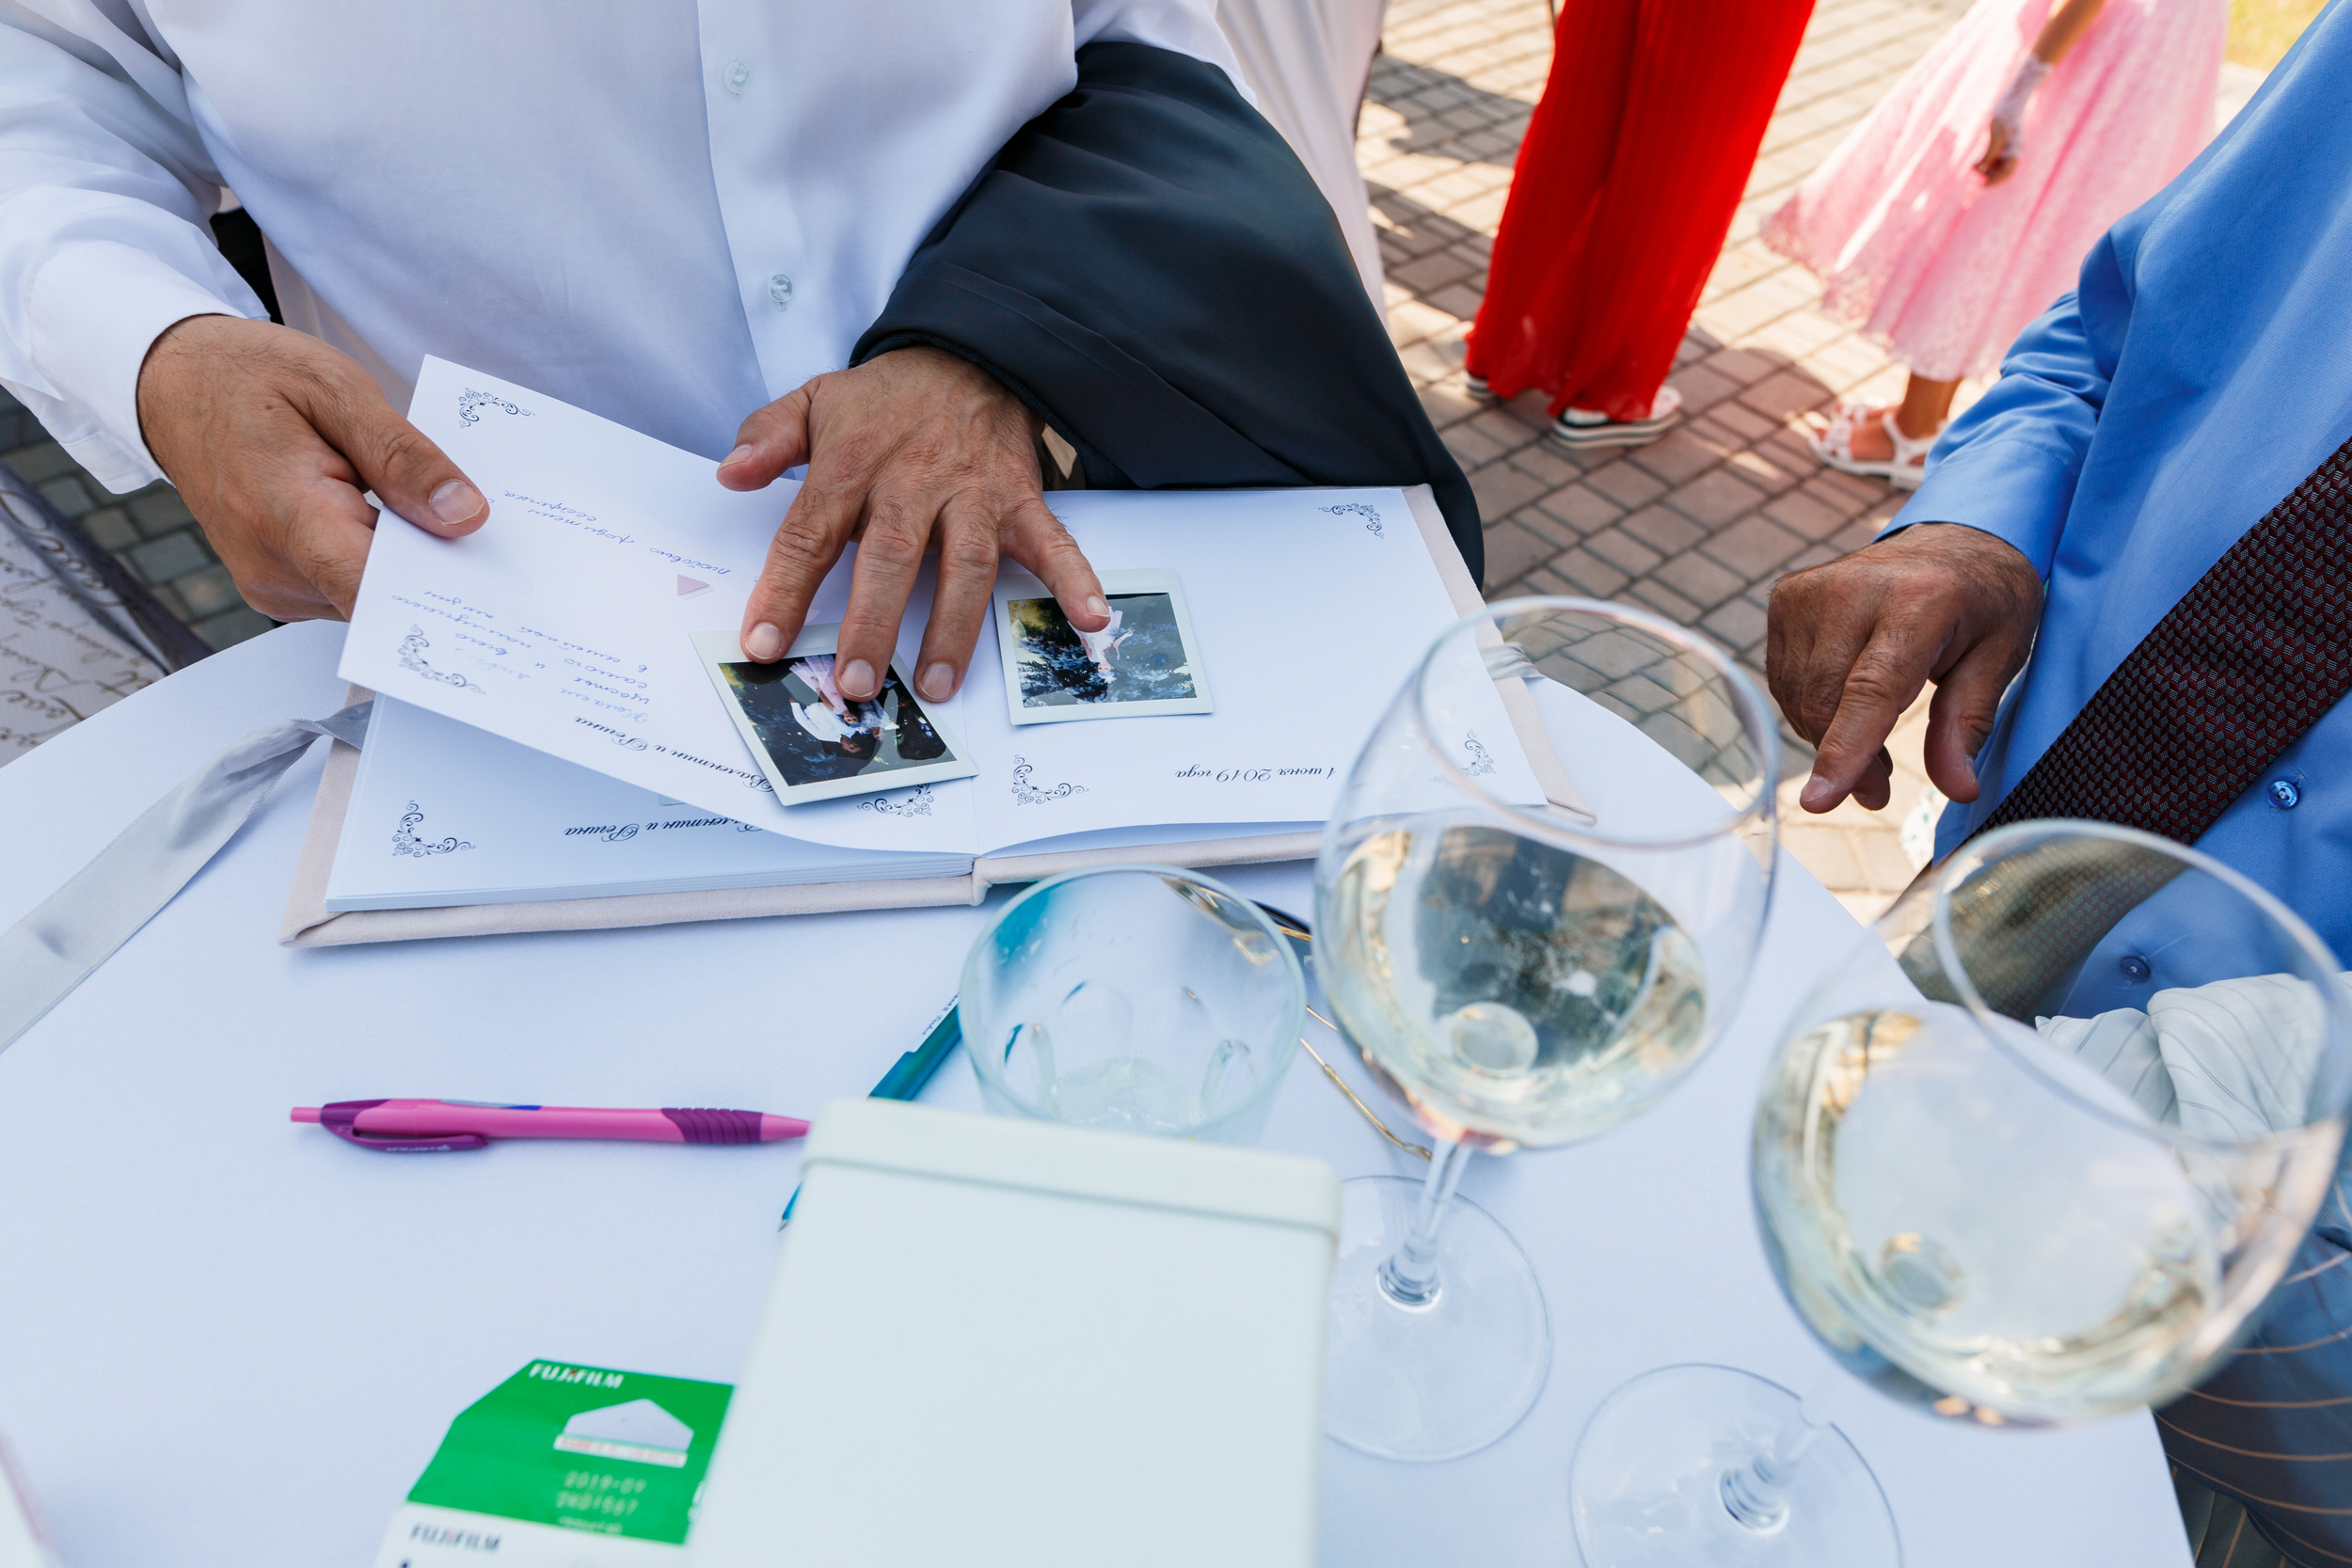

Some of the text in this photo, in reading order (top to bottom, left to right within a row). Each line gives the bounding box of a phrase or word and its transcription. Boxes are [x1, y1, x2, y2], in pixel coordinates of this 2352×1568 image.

[574, 716, 774, 793] Валентин и Регина
[1174, 763, 1337, 784] 1 июня 2019 года
[564, 822, 641, 843] Регина
[645, 821, 660, 832] и
[528, 1362, 625, 1390] FUJIFILM
